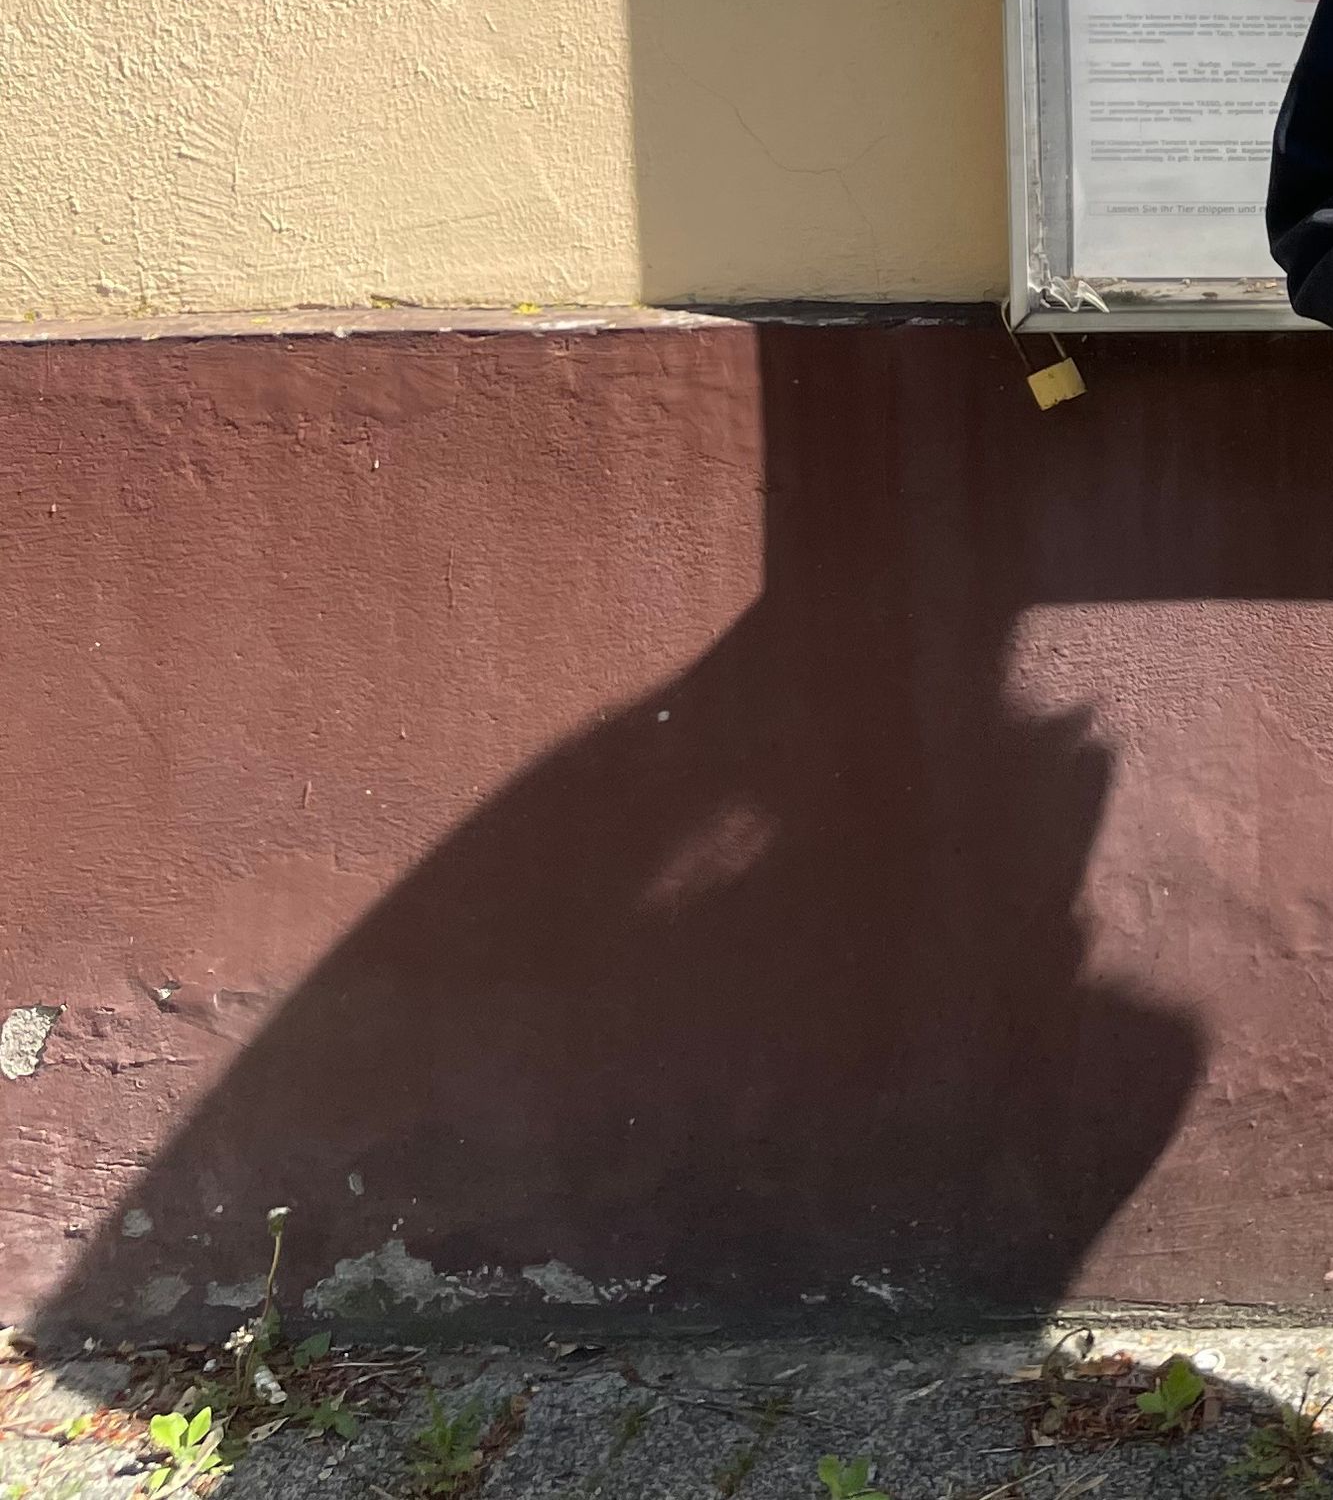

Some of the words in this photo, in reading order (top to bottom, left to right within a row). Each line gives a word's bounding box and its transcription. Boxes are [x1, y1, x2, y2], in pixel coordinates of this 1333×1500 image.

[1106, 204, 1140, 214] Lassen
[1142, 204, 1158, 214] Sie
[1177, 204, 1195, 214] Tier
[1197, 204, 1236, 217] chippen
[1237, 204, 1257, 214] und
